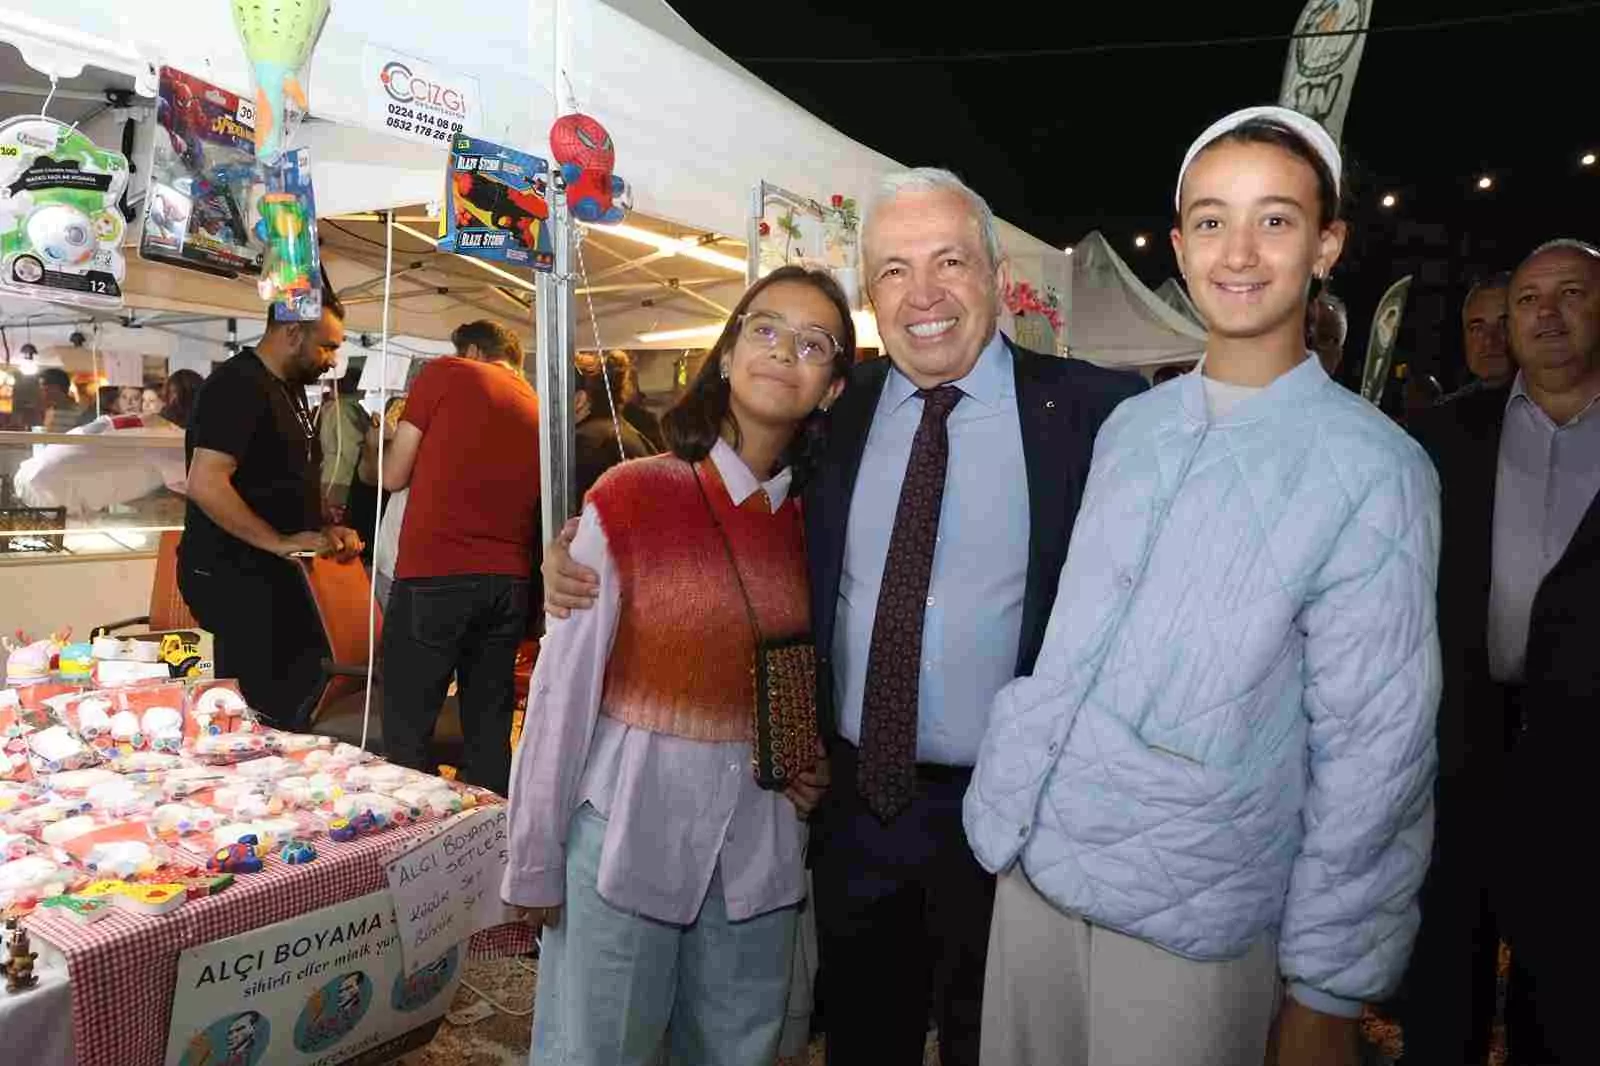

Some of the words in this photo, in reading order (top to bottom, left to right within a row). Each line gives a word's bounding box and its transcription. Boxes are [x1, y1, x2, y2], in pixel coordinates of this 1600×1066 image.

[386, 116, 412, 132] 0532
[414, 124, 433, 137] 178
[432, 130, 446, 141] 26
[388, 103, 414, 119] 0224
[416, 112, 435, 125] 414
[436, 118, 449, 129] 08
[450, 122, 464, 133] 08
[457, 155, 478, 170] BLAZE
[479, 157, 501, 172] STORM
[460, 231, 482, 246] BLAZE
[483, 234, 506, 247] STORM
[89, 280, 107, 293] 12
[195, 950, 265, 990] ALÇI
[273, 913, 383, 965] BOYAMA
